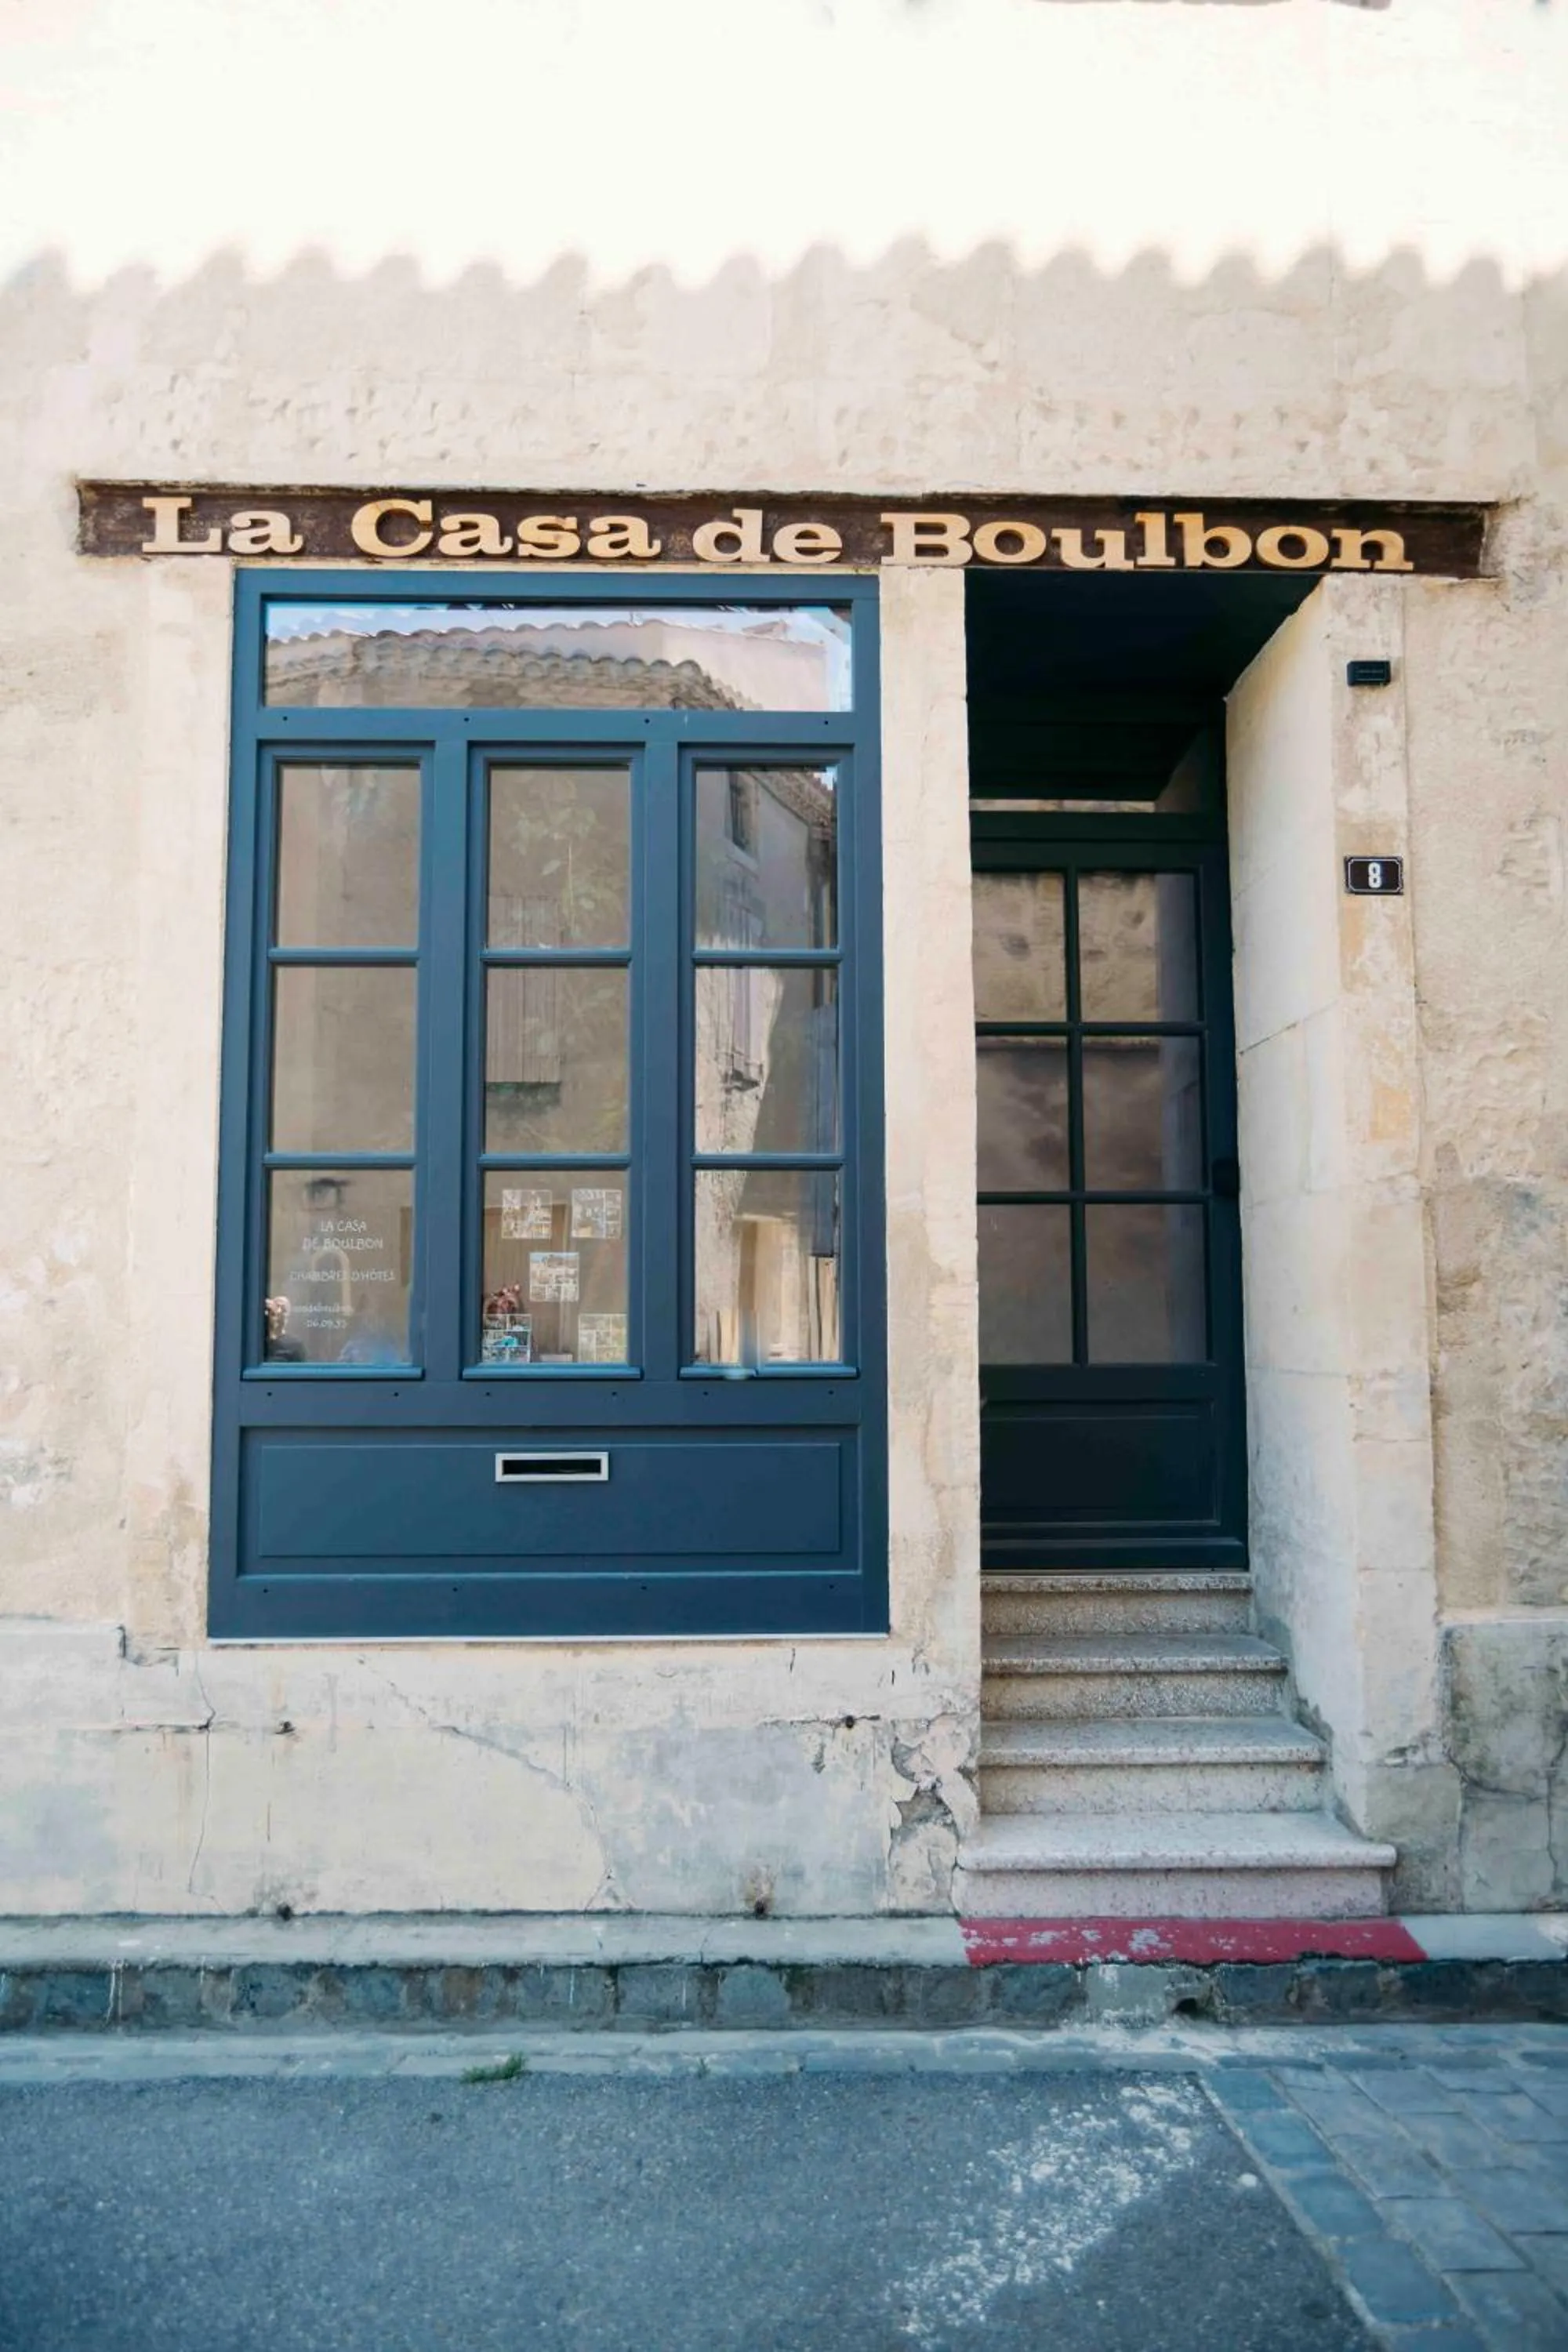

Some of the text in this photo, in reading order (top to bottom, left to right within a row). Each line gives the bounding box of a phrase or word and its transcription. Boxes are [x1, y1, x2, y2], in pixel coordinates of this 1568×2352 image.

[142, 495, 1414, 572] La Casa de Boulbon
[1367, 862, 1382, 890] 8
[320, 1218, 368, 1233] LA CASA
[302, 1236, 384, 1252] DE BOULBON
